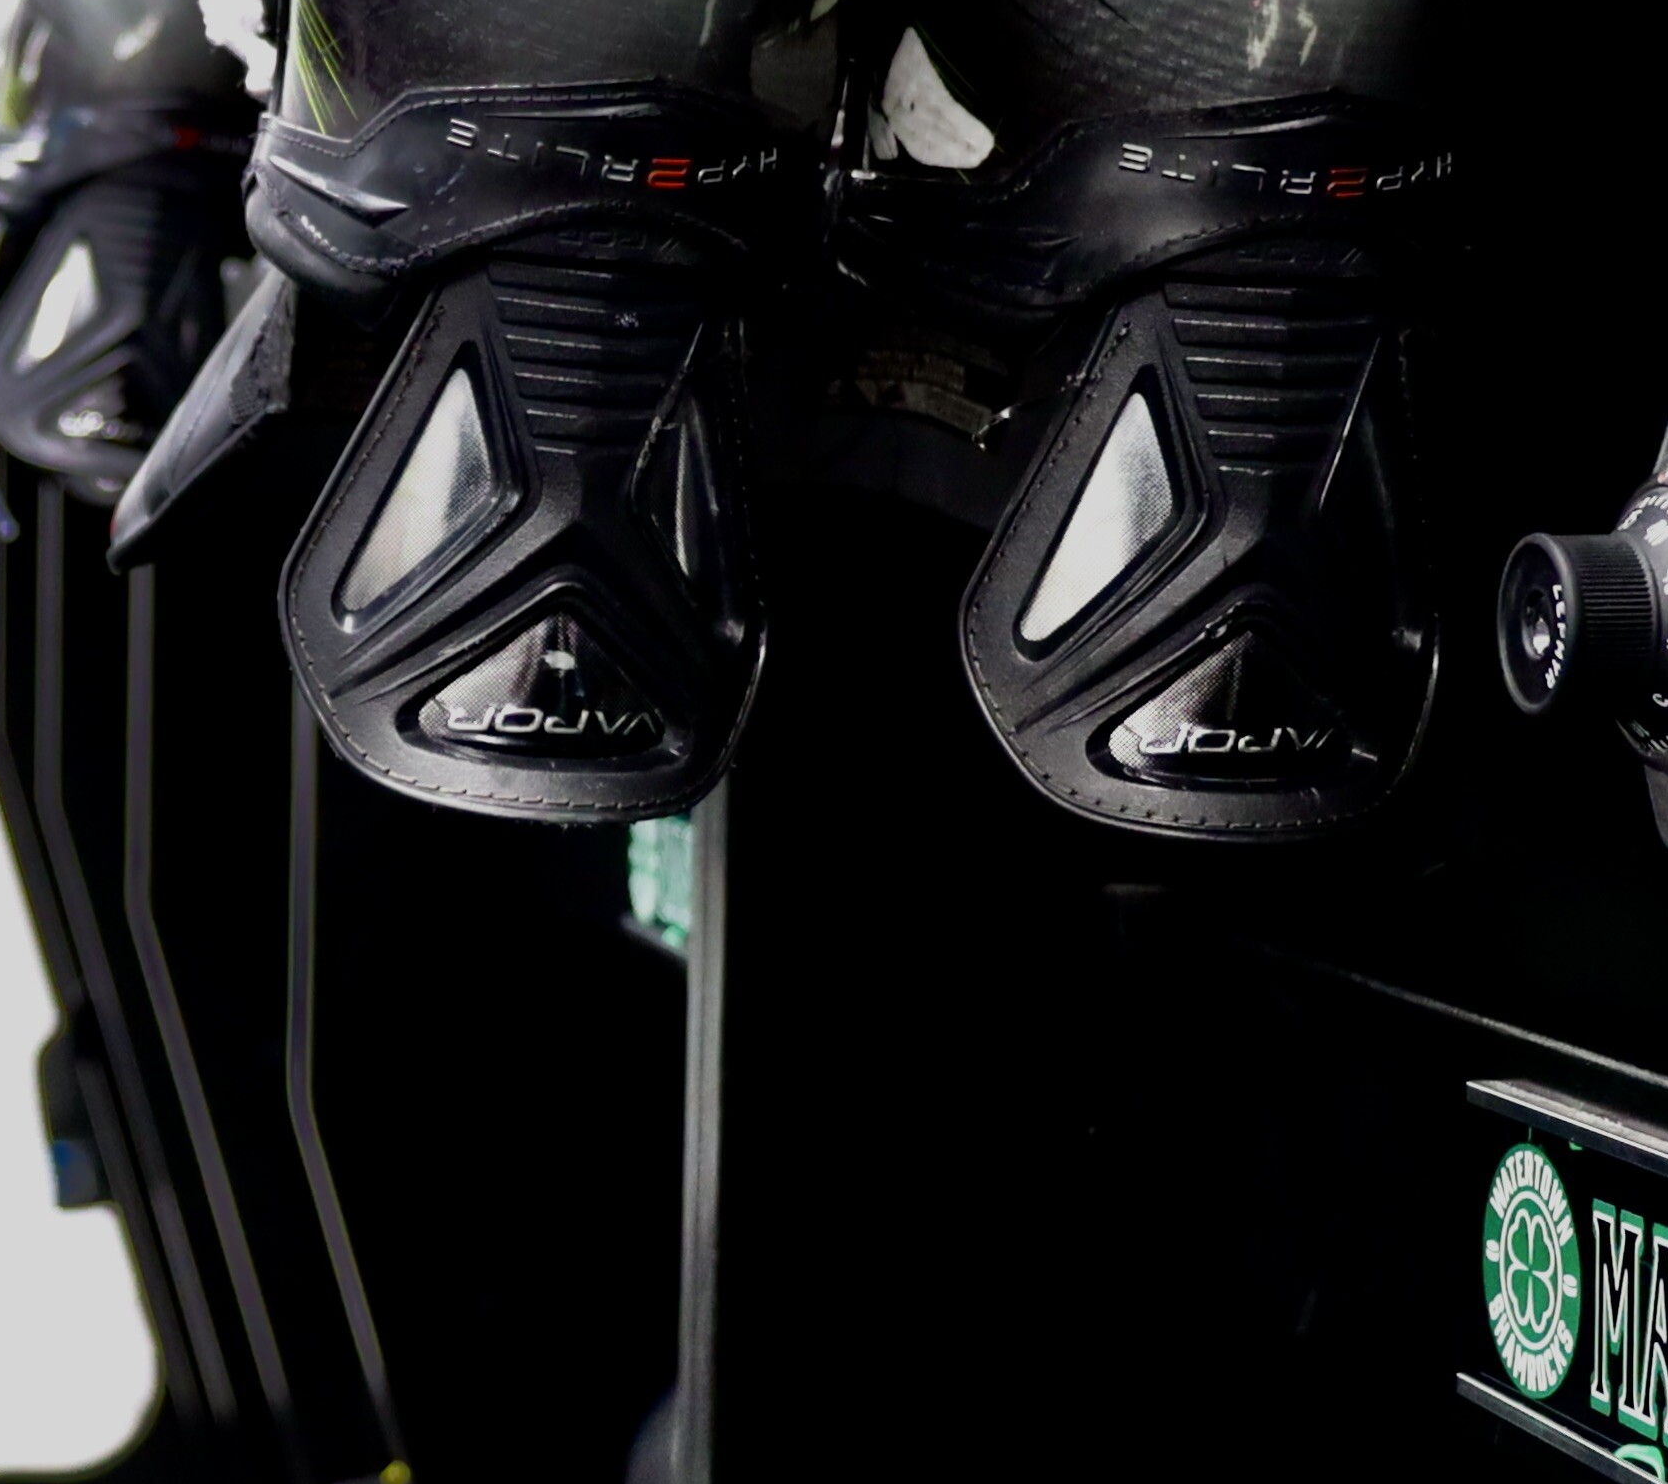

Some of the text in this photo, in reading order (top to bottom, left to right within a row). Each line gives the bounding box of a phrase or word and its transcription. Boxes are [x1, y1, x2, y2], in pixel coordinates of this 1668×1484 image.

[443, 702, 657, 736] VAPOR
[1489, 1150, 1574, 1248] WATERTOWN
[1488, 1292, 1574, 1393] SHAMROCKS
